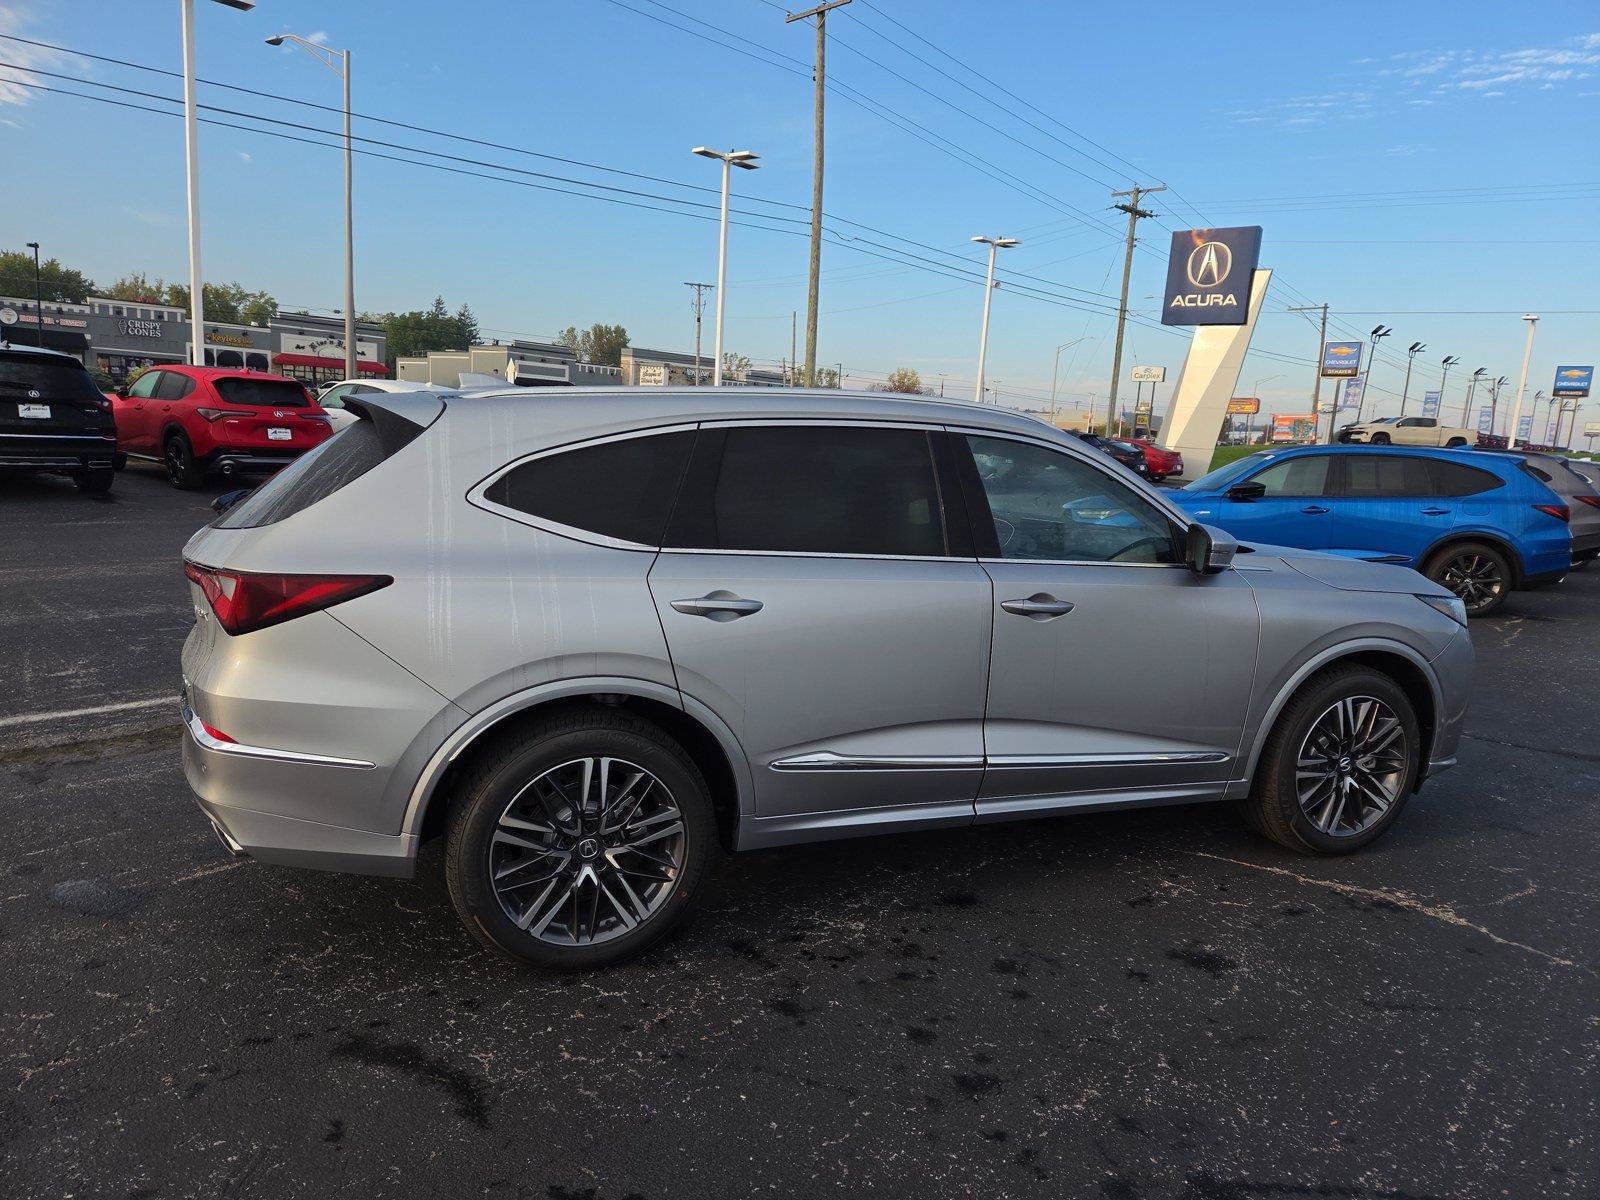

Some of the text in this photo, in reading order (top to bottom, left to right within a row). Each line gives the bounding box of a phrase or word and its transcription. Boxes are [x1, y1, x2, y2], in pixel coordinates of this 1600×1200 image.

[1170, 293, 1238, 307] ACURA
[127, 319, 161, 330] CRISPY
[127, 328, 162, 338] CONES
[1133, 372, 1161, 381] Carplex
